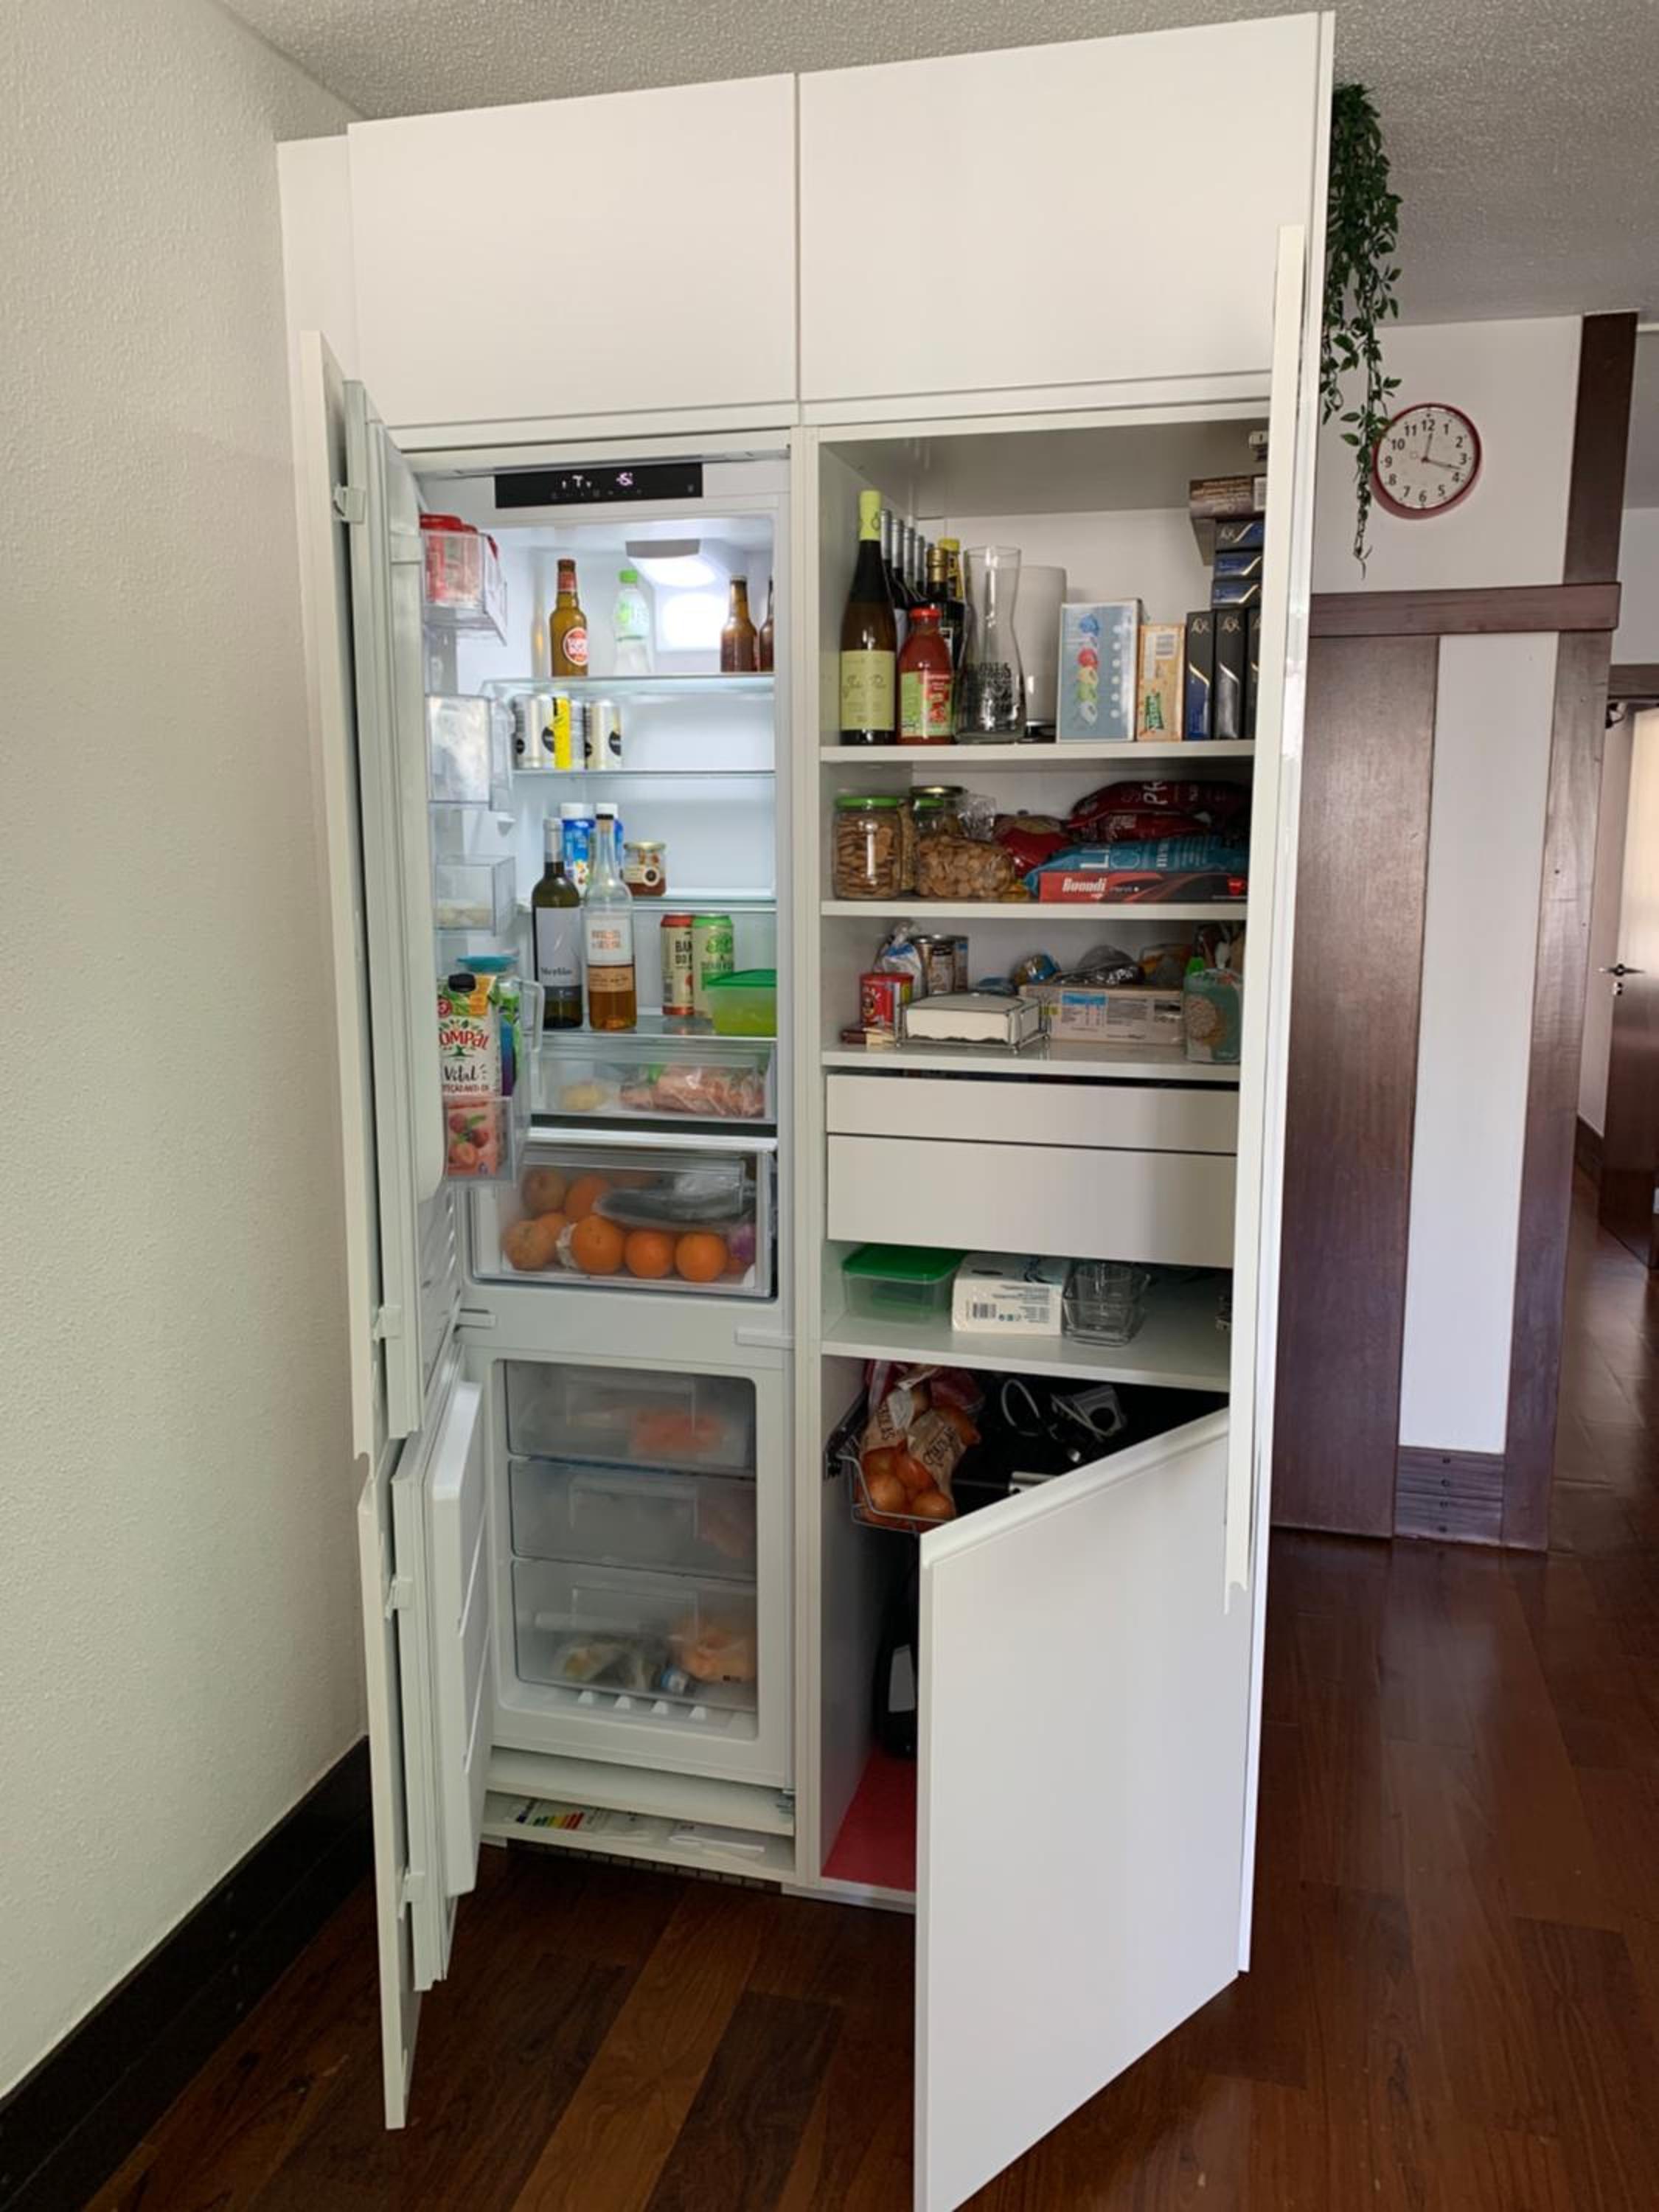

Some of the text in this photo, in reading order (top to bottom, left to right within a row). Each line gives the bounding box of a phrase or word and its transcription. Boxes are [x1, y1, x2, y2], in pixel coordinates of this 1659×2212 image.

[1405, 425, 1417, 437] 11
[1422, 419, 1436, 431] 12
[1444, 423, 1450, 435] 1
[1392, 439, 1405, 451] 10
[1455, 436, 1464, 448] 2
[1384, 456, 1393, 468] 9
[1460, 453, 1467, 465] 3
[1388, 473, 1397, 486] 8
[1453, 472, 1460, 483] 4
[1403, 486, 1411, 498] 7
[1419, 490, 1427, 502] 6
[1439, 484, 1446, 496] 5
[439, 1030, 490, 1050] OMPal
[445, 1065, 477, 1082] Vital
